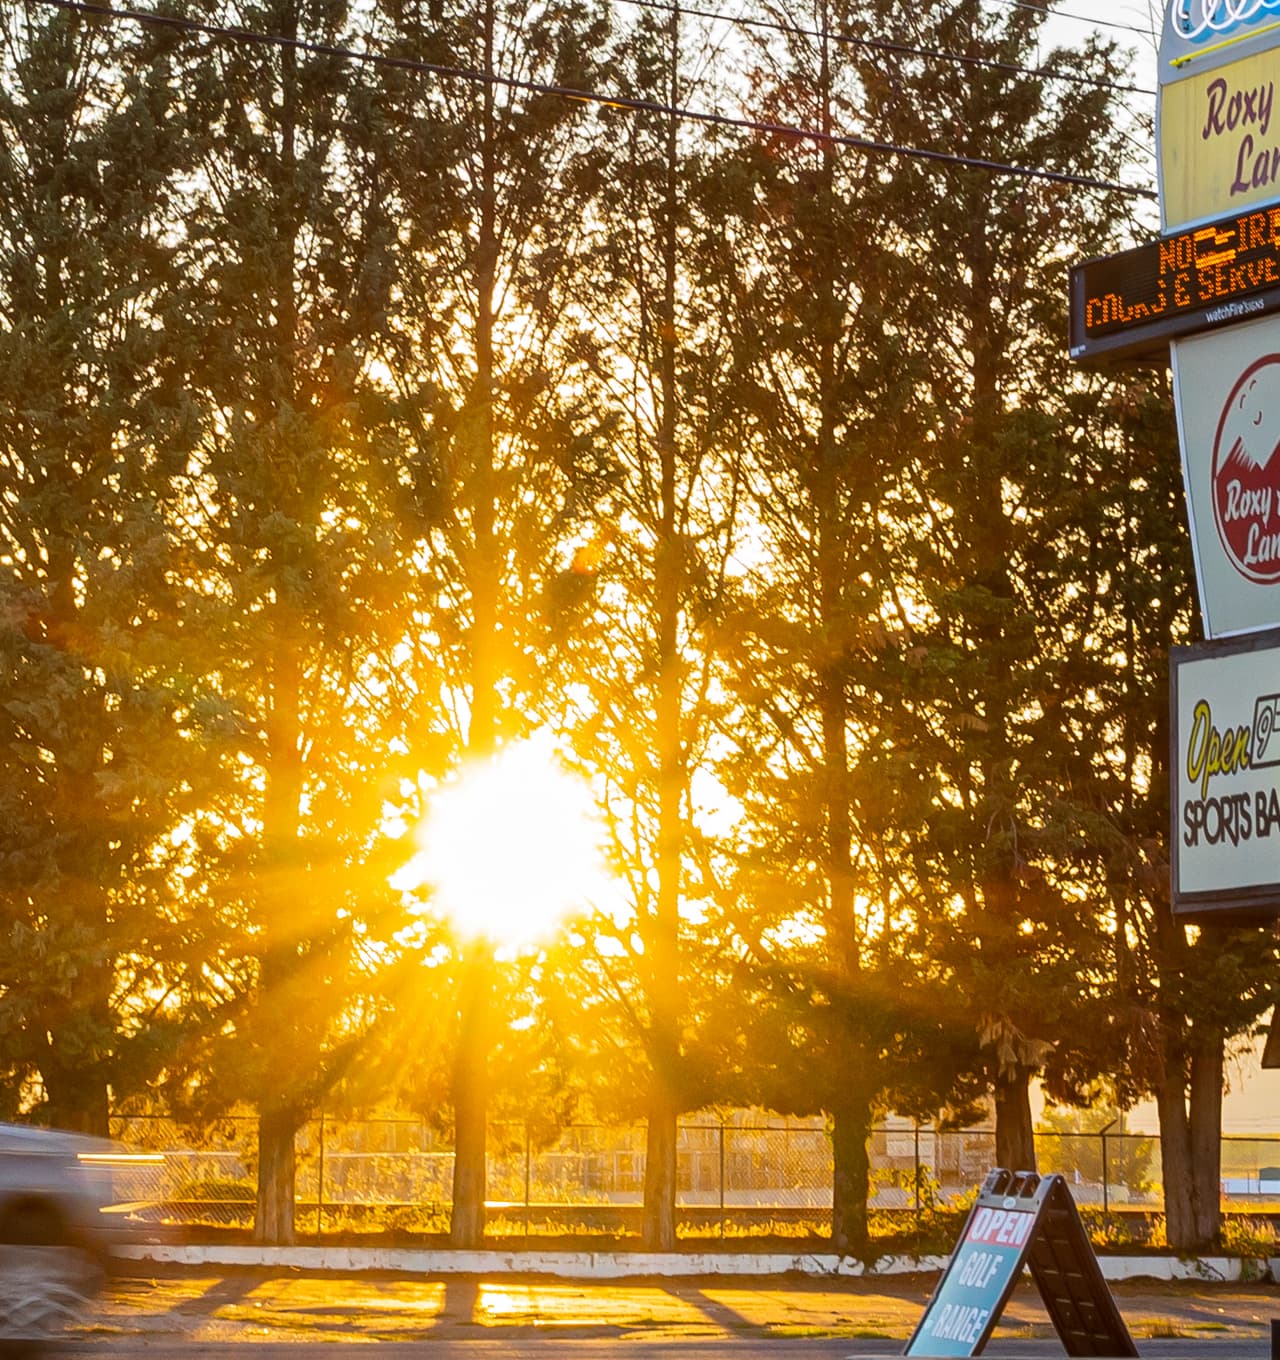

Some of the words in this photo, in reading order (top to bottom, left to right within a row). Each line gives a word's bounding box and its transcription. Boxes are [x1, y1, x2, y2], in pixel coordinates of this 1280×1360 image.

[1202, 77, 1274, 140] Roxy
[1224, 478, 1272, 529] Roxy
[1187, 698, 1251, 801] Open
[1184, 792, 1252, 847] SPORTS
[970, 1208, 1035, 1245] OPEN
[958, 1251, 1003, 1288] GOLF
[931, 1304, 990, 1344] RANGE
